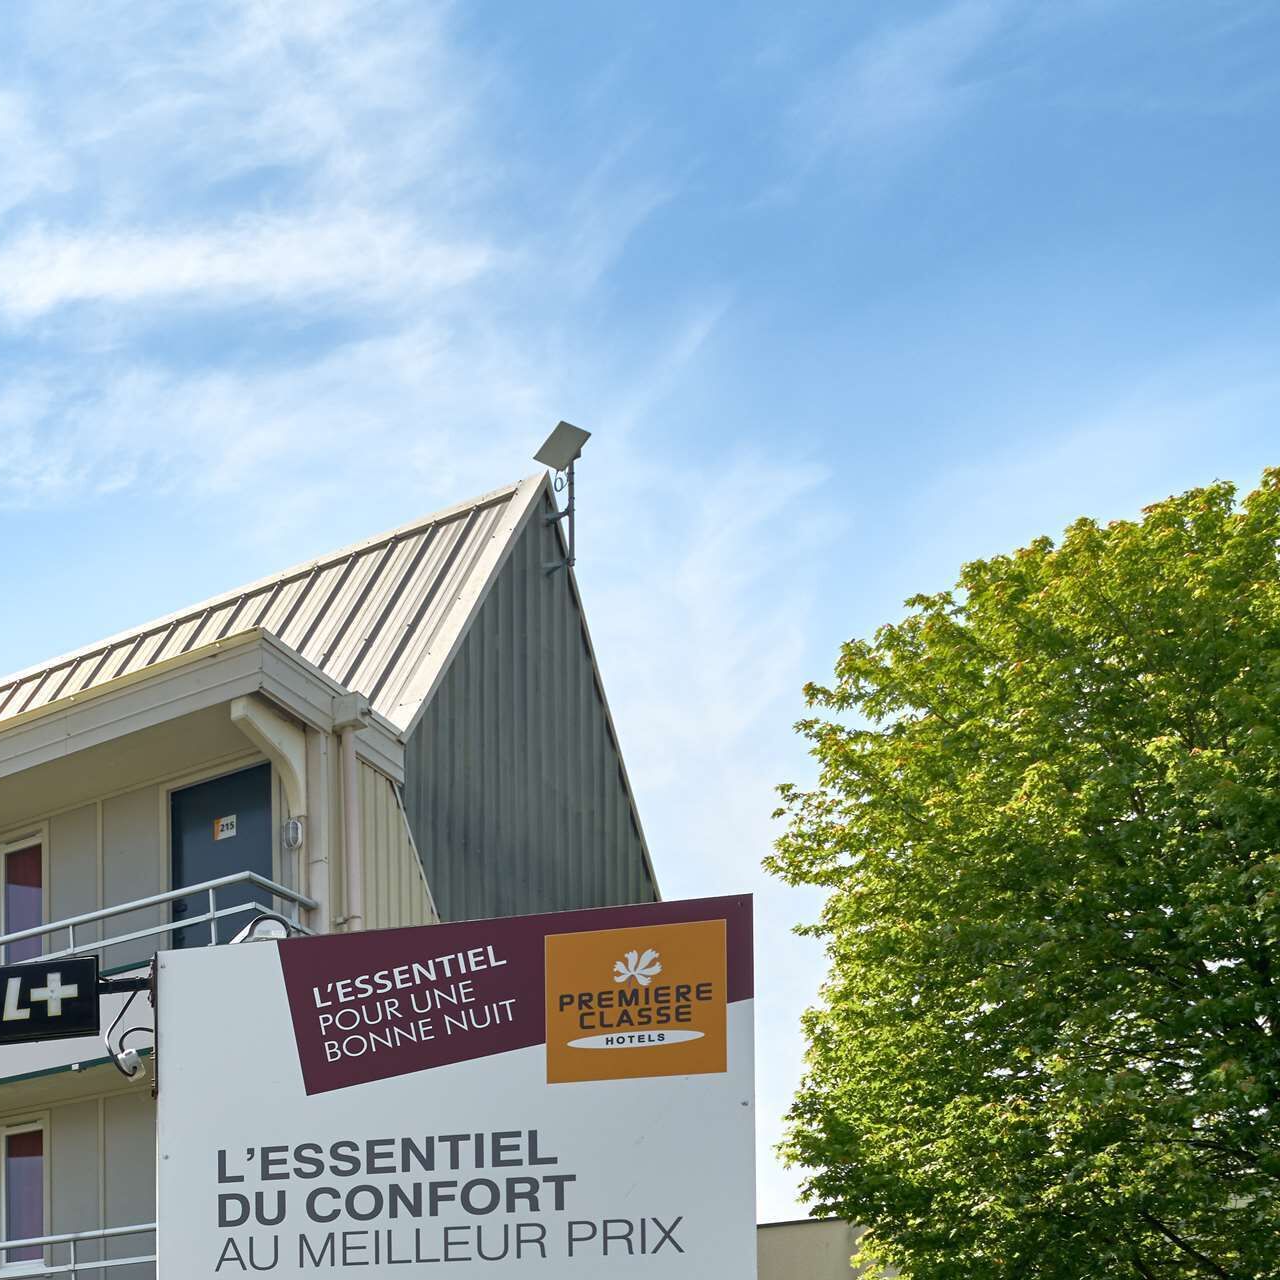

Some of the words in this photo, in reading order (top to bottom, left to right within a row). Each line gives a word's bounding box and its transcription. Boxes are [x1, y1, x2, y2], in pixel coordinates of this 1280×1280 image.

[220, 821, 234, 832] 215
[312, 944, 507, 1008] L'ESSENTIEL
[558, 981, 713, 1013] PREMIERE
[319, 997, 402, 1036] POUR
[410, 980, 476, 1014] UNE
[323, 1017, 435, 1063] BONNE
[443, 998, 517, 1035] NUIT
[578, 1003, 693, 1030] CLASSE
[605, 1032, 665, 1046] HOTELS
[216, 1129, 558, 1185] L'ESSENTIEL
[216, 1188, 286, 1229] DU
[304, 1173, 577, 1222] CONFORT
[214, 1233, 280, 1273] AU
[298, 1222, 548, 1270] MEILLEUR
[566, 1216, 686, 1258] PRIX
